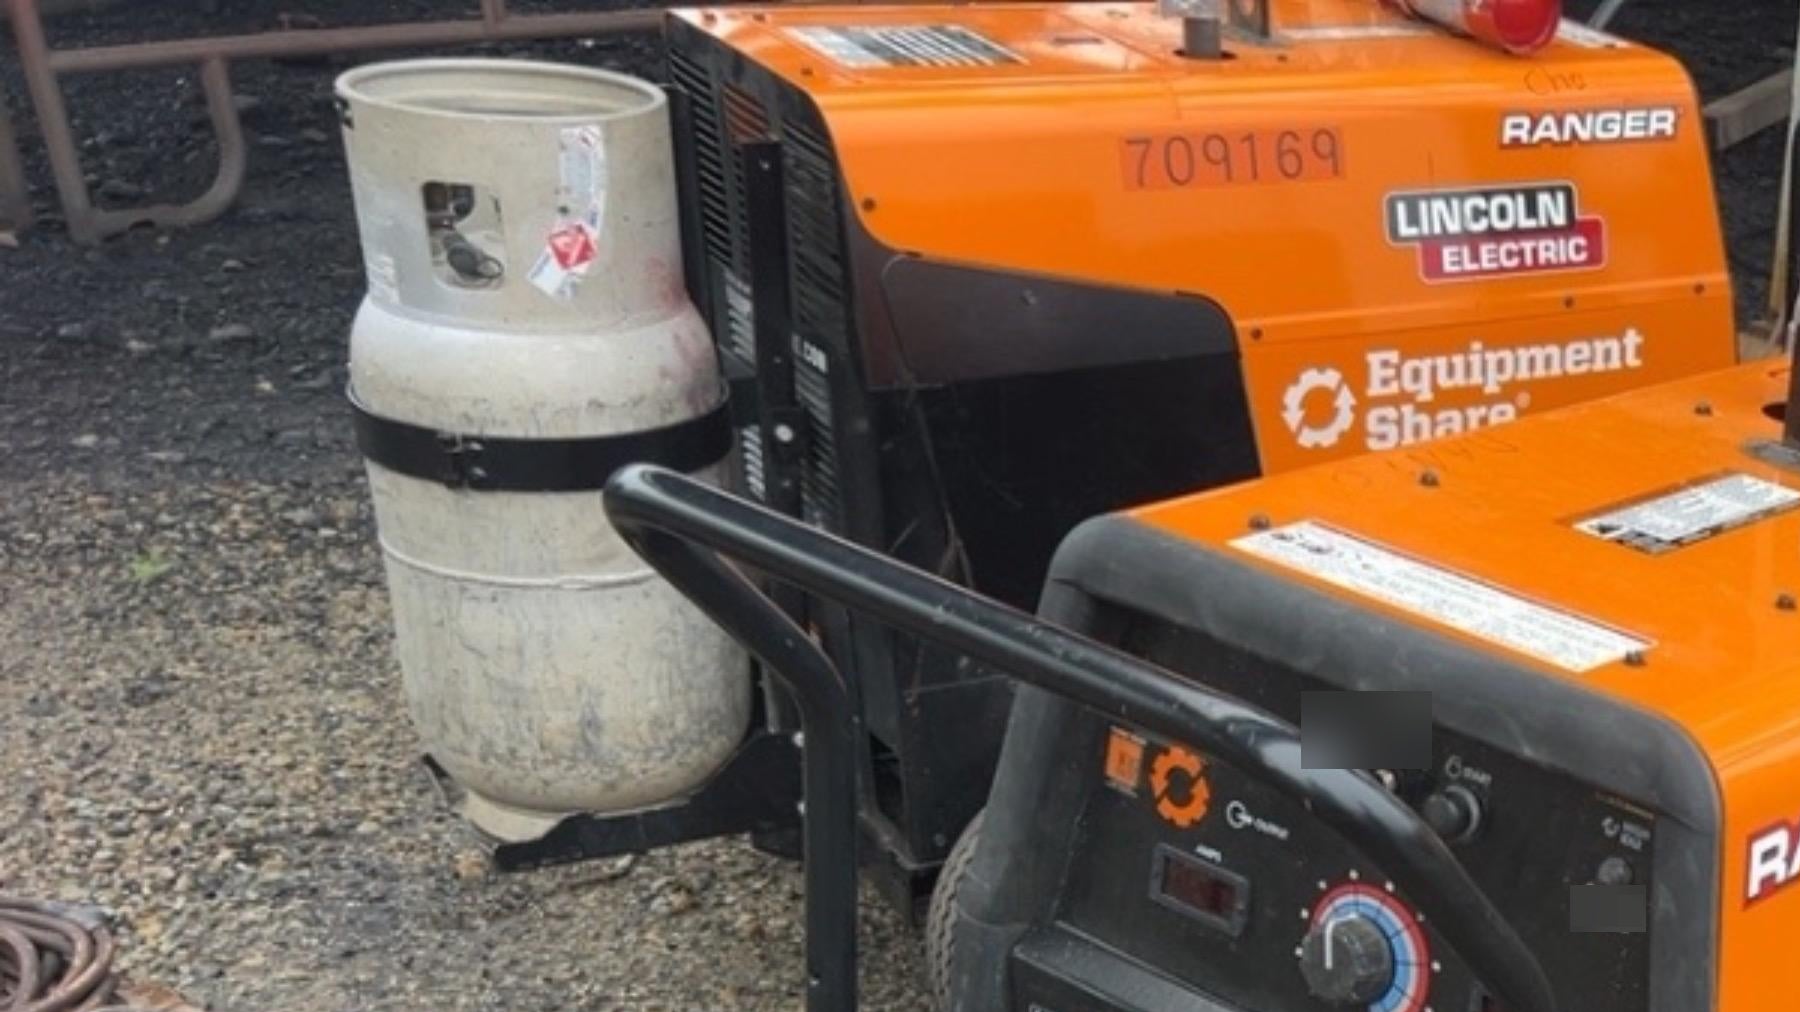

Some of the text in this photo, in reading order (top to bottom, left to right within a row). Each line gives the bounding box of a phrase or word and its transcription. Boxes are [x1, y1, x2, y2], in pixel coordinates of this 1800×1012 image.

[1502, 107, 1676, 145] RANGER
[1125, 128, 1340, 188] 709169
[1396, 190, 1569, 238] LINCOLN
[1442, 235, 1589, 274] ELECTRIC
[1366, 328, 1643, 402] Equipment
